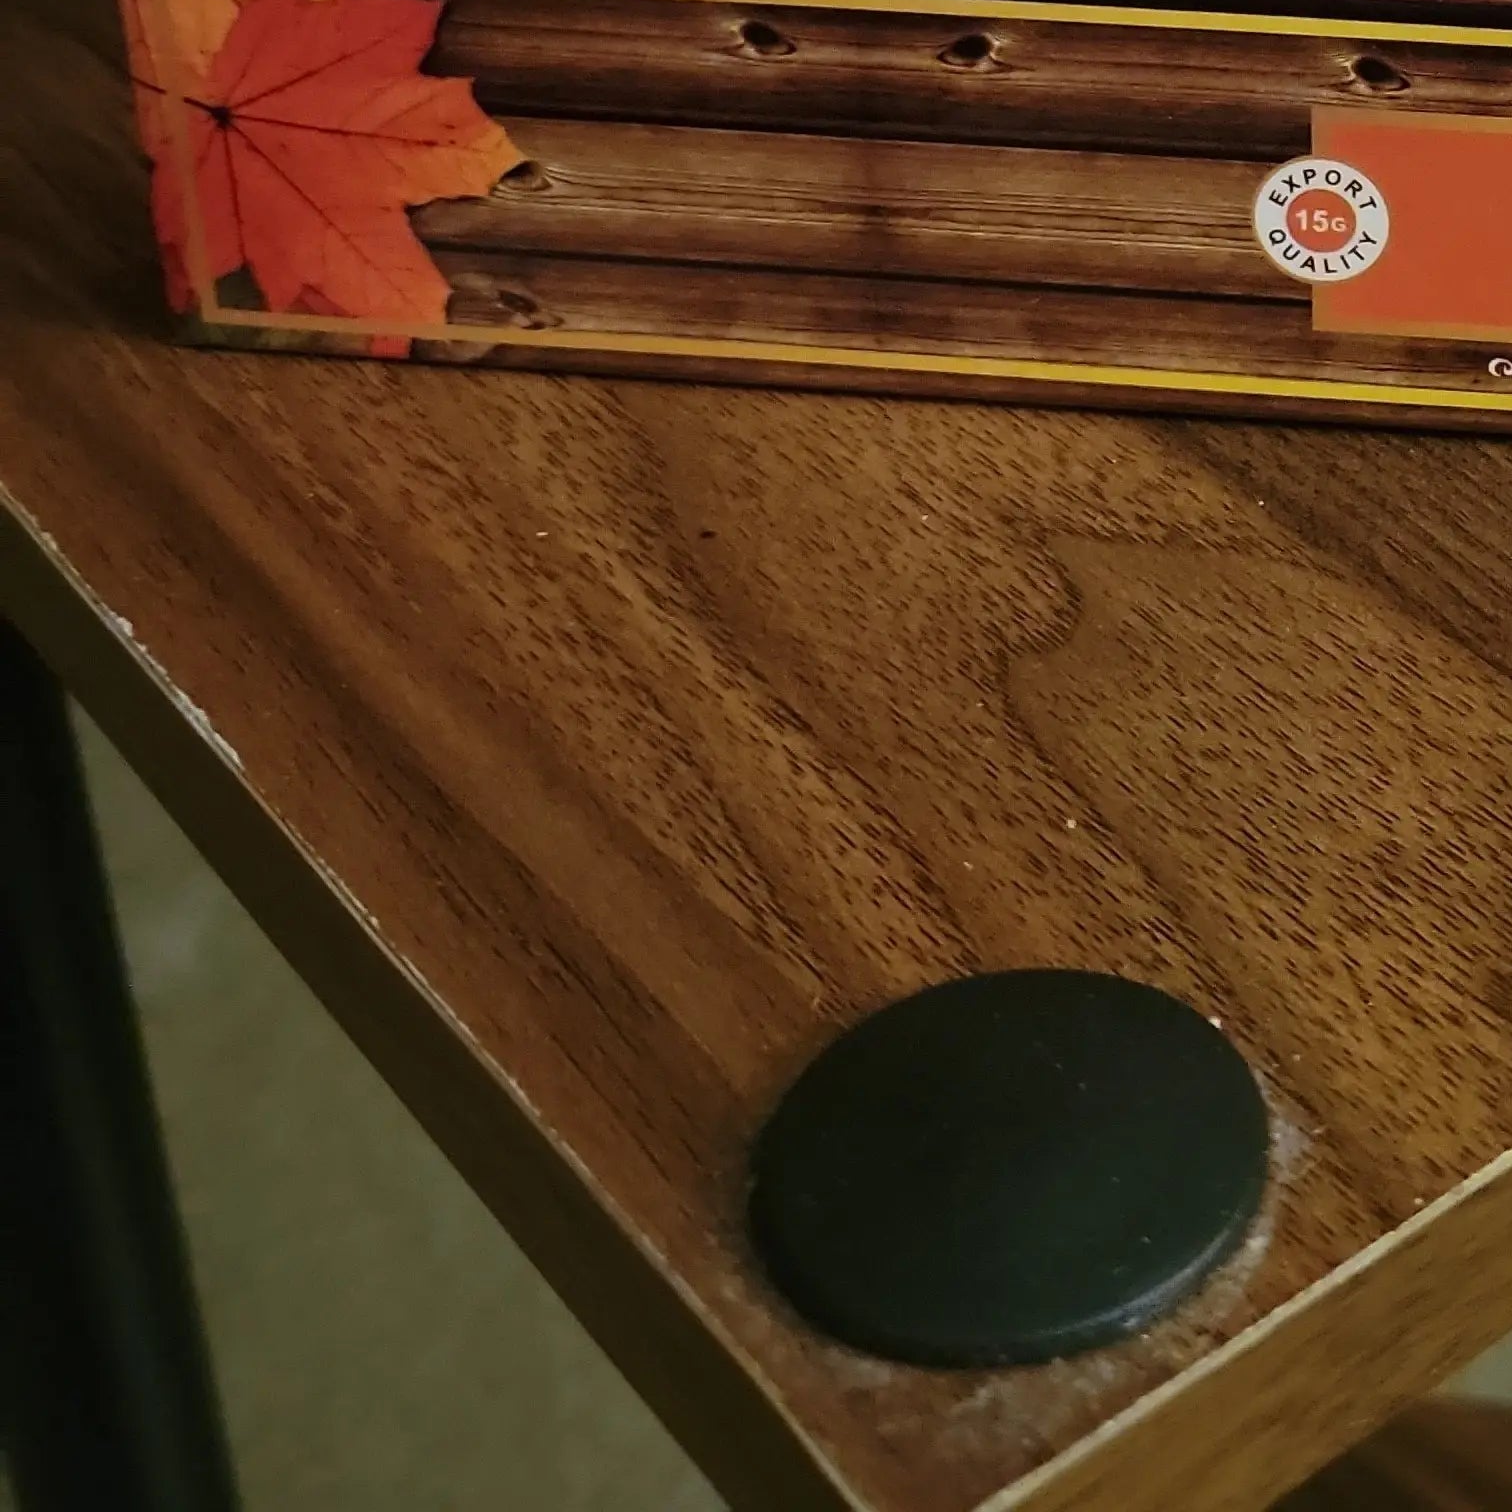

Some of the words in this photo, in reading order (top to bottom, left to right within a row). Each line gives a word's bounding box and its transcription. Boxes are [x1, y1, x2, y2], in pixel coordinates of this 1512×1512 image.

[1268, 169, 1377, 209] EXPORT
[1295, 209, 1347, 232] 15G
[1268, 230, 1377, 274] QUALITY
